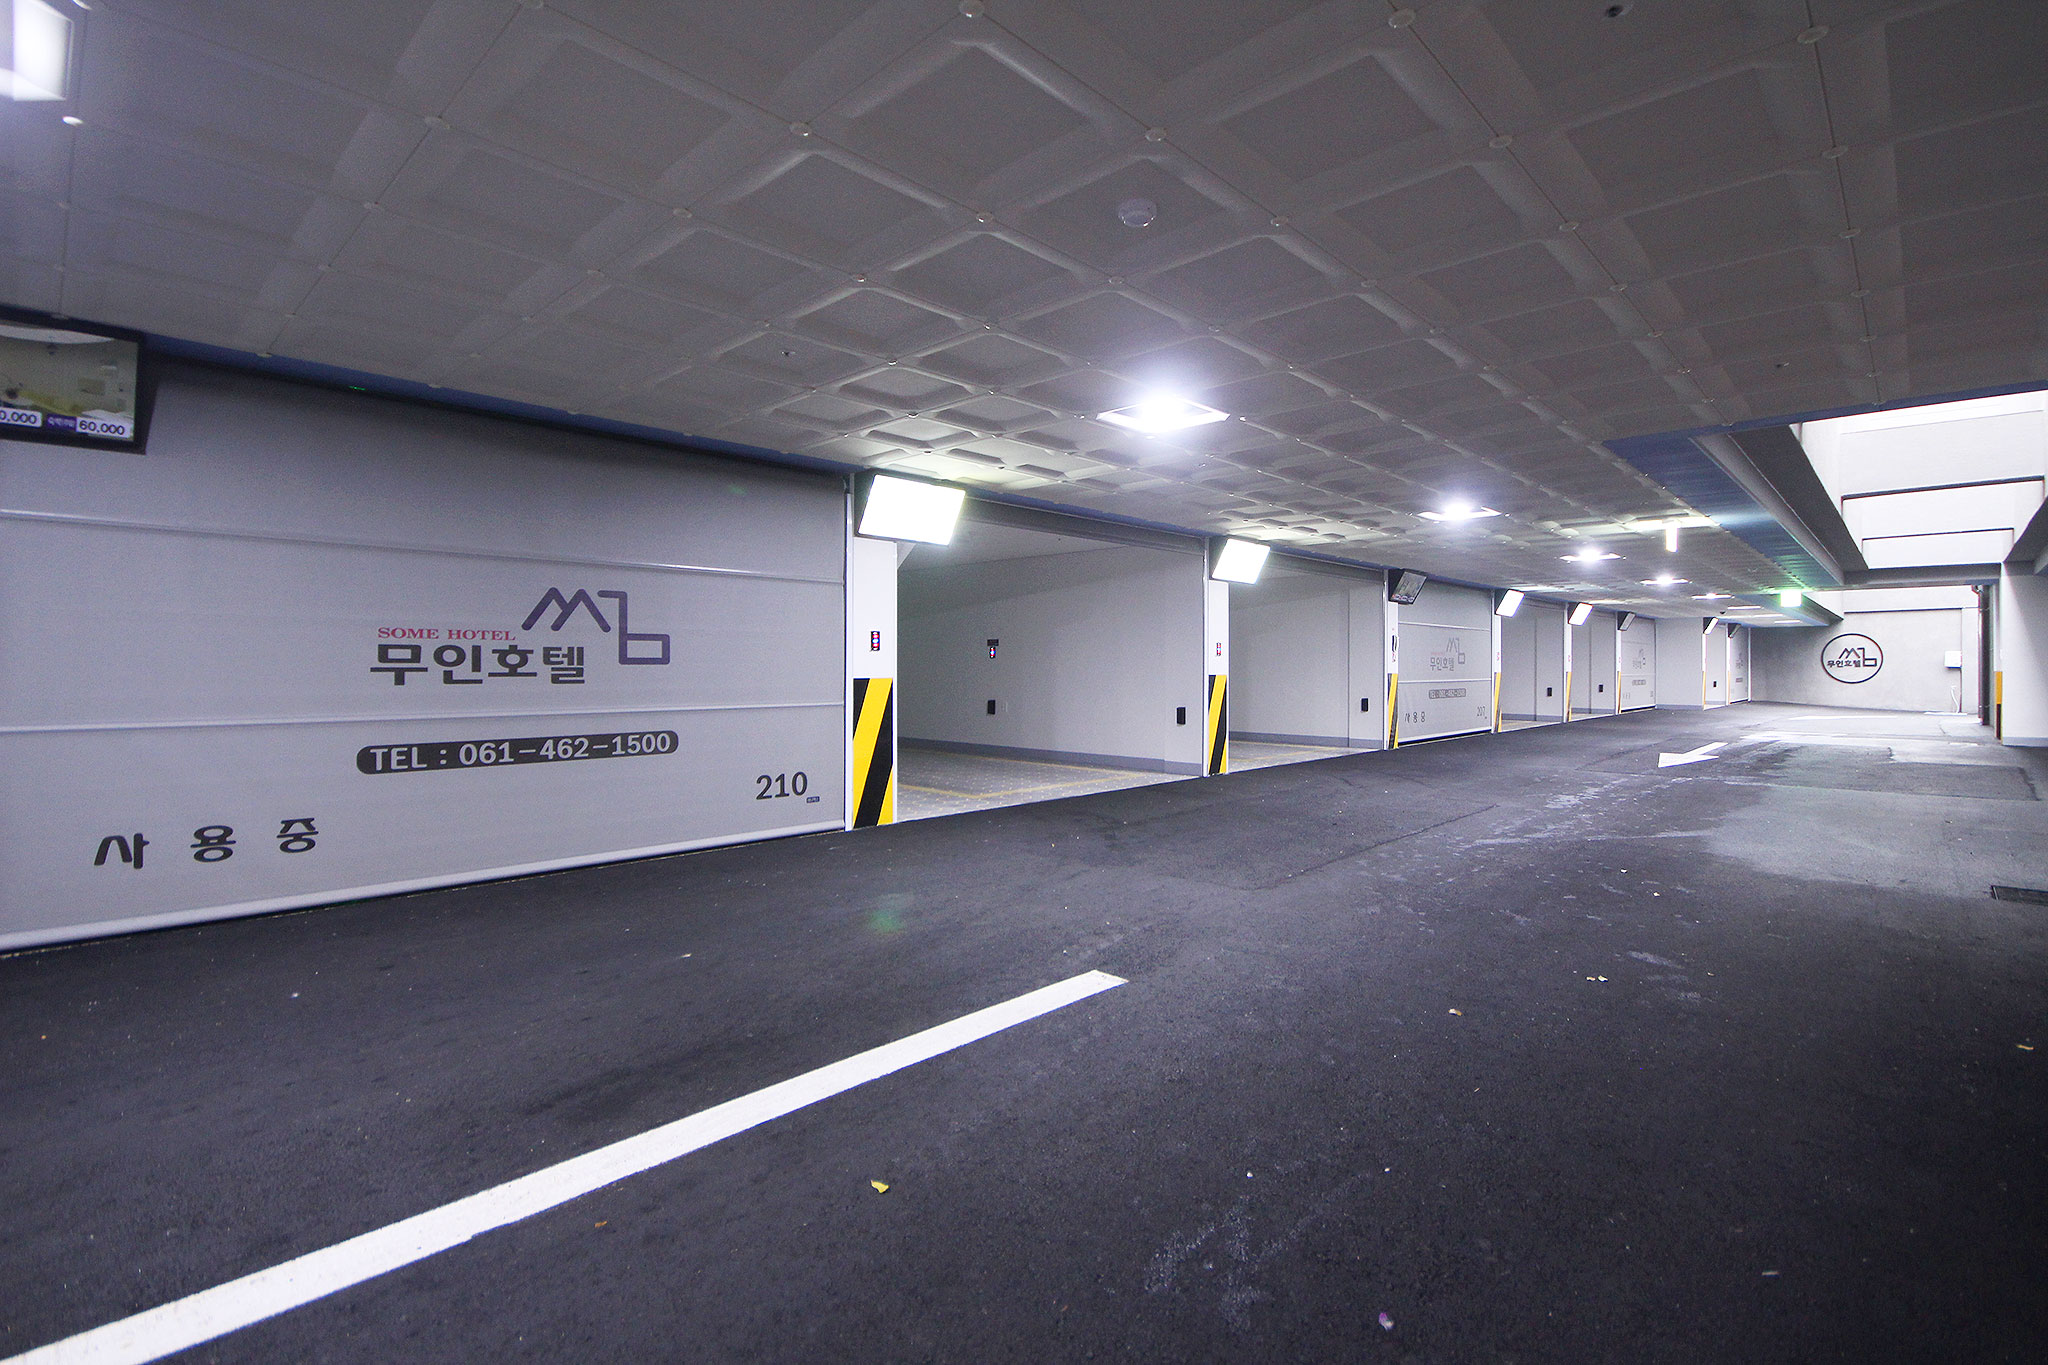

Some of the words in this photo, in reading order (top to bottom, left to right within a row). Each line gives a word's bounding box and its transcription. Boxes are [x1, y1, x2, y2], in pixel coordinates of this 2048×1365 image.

[378, 627, 439, 640] SOME
[447, 629, 517, 641] HOTEL
[370, 644, 586, 686] 무인호텔
[459, 732, 672, 766] 061-462-1500
[756, 771, 808, 800] 210
